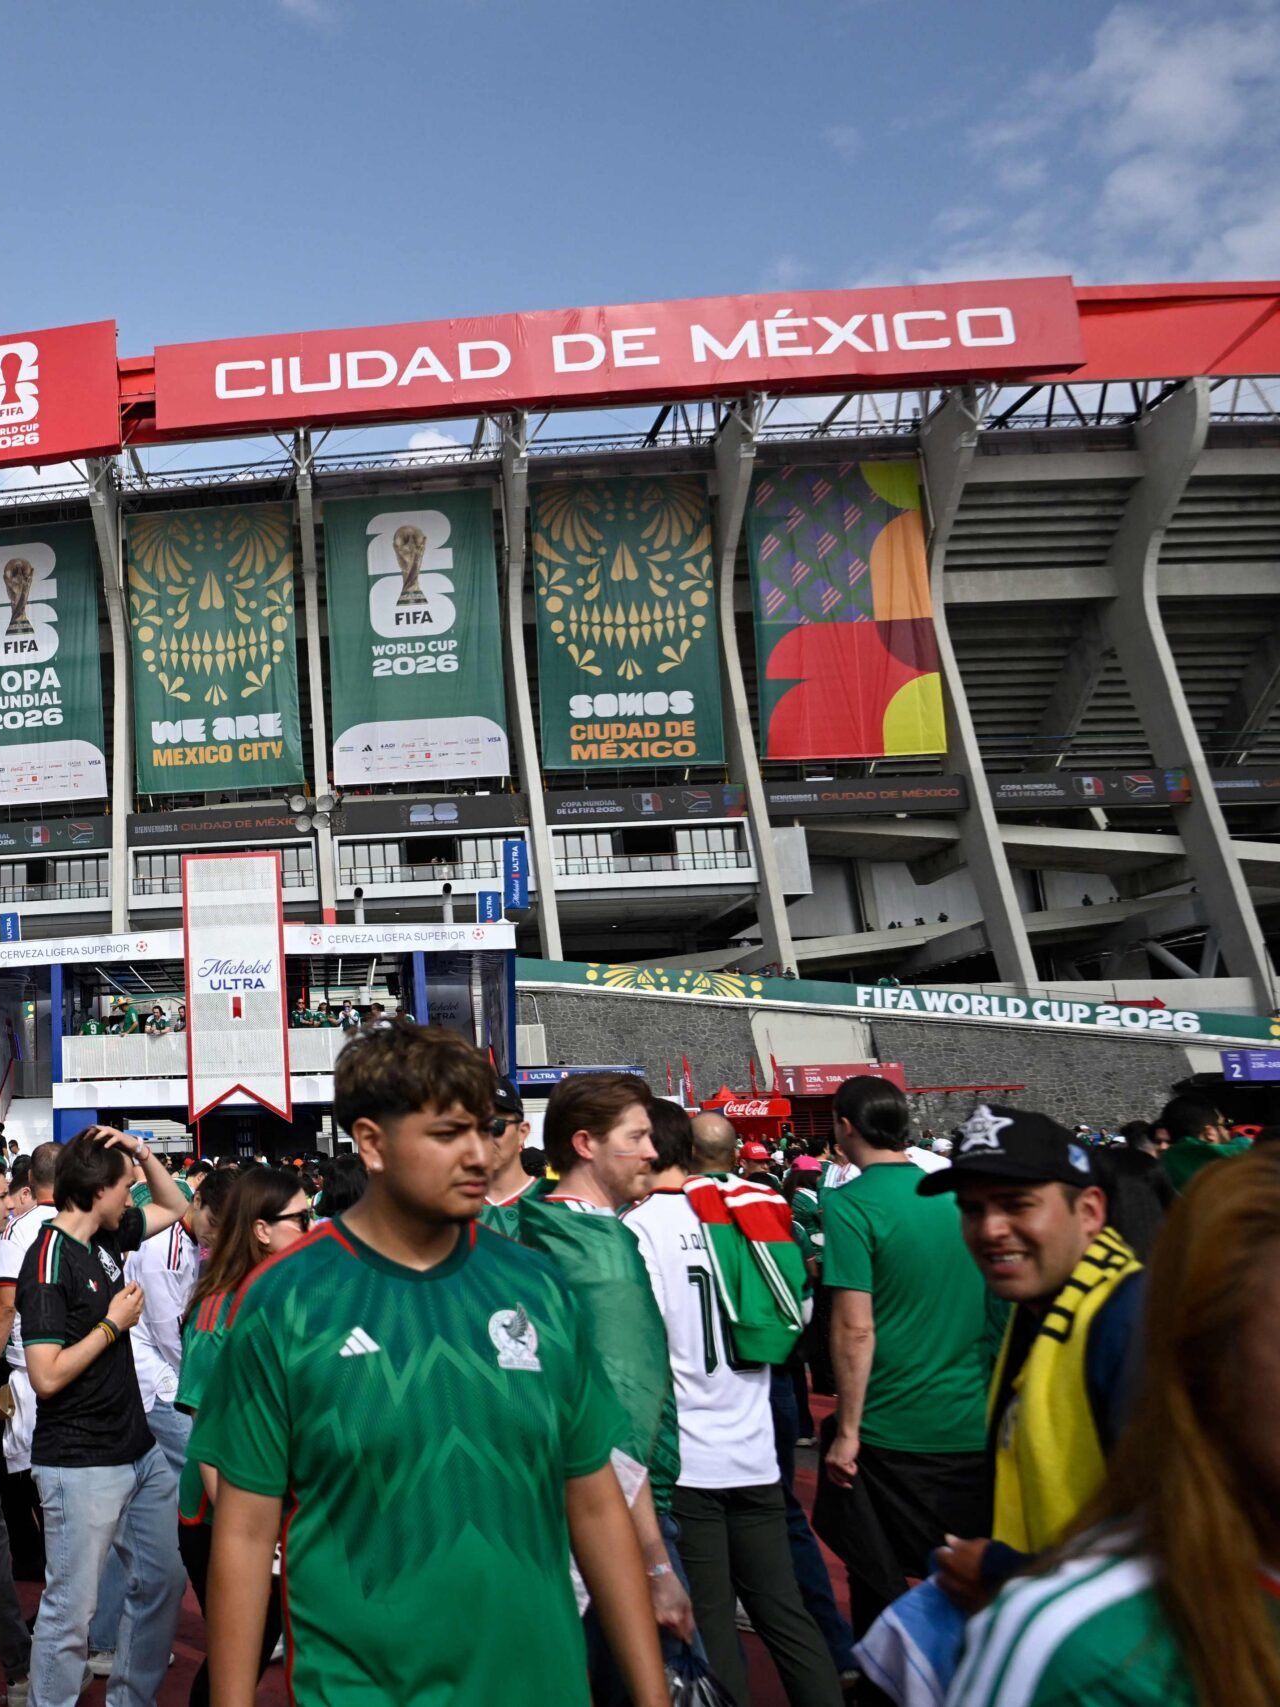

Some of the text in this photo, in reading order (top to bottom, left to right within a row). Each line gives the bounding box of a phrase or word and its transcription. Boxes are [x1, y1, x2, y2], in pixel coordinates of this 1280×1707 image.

[214, 306, 1016, 400] CIUDAD DE MÉXICO
[0, 406, 24, 417] FIFA
[20, 423, 39, 433] CUP
[394, 610, 433, 626] FIFA
[4, 639, 38, 654] FIFA
[371, 639, 458, 657] WORLD CUP
[372, 653, 459, 677] 2026
[569, 690, 695, 718] SOMOS
[151, 712, 283, 744] WE ARE
[570, 720, 696, 741] CIUDAD DE
[152, 740, 283, 767] MEXICO CITY
[571, 739, 696, 760] MÉXICO
[821, 790, 877, 801] CIUDAD
[879, 790, 898, 799] DE
[902, 787, 960, 798] MÉXICO
[582, 799, 617, 807] MUNDIAL
[181, 821, 232, 832] CIUDAD
[234, 819, 252, 828] DE
[255, 817, 298, 827] MÉXIC
[327, 930, 465, 944] CERVEZA LIGERA SUPERIOR
[0, 944, 130, 960] CERVEZA LIGERA SUPERIOR
[197, 959, 272, 978] Michelob
[210, 978, 265, 991] ULTRA
[856, 986, 1201, 1033] FIFA WORLD CUP 2026
[1231, 1064, 1244, 1078] 2
[785, 1077, 795, 1092] 1
